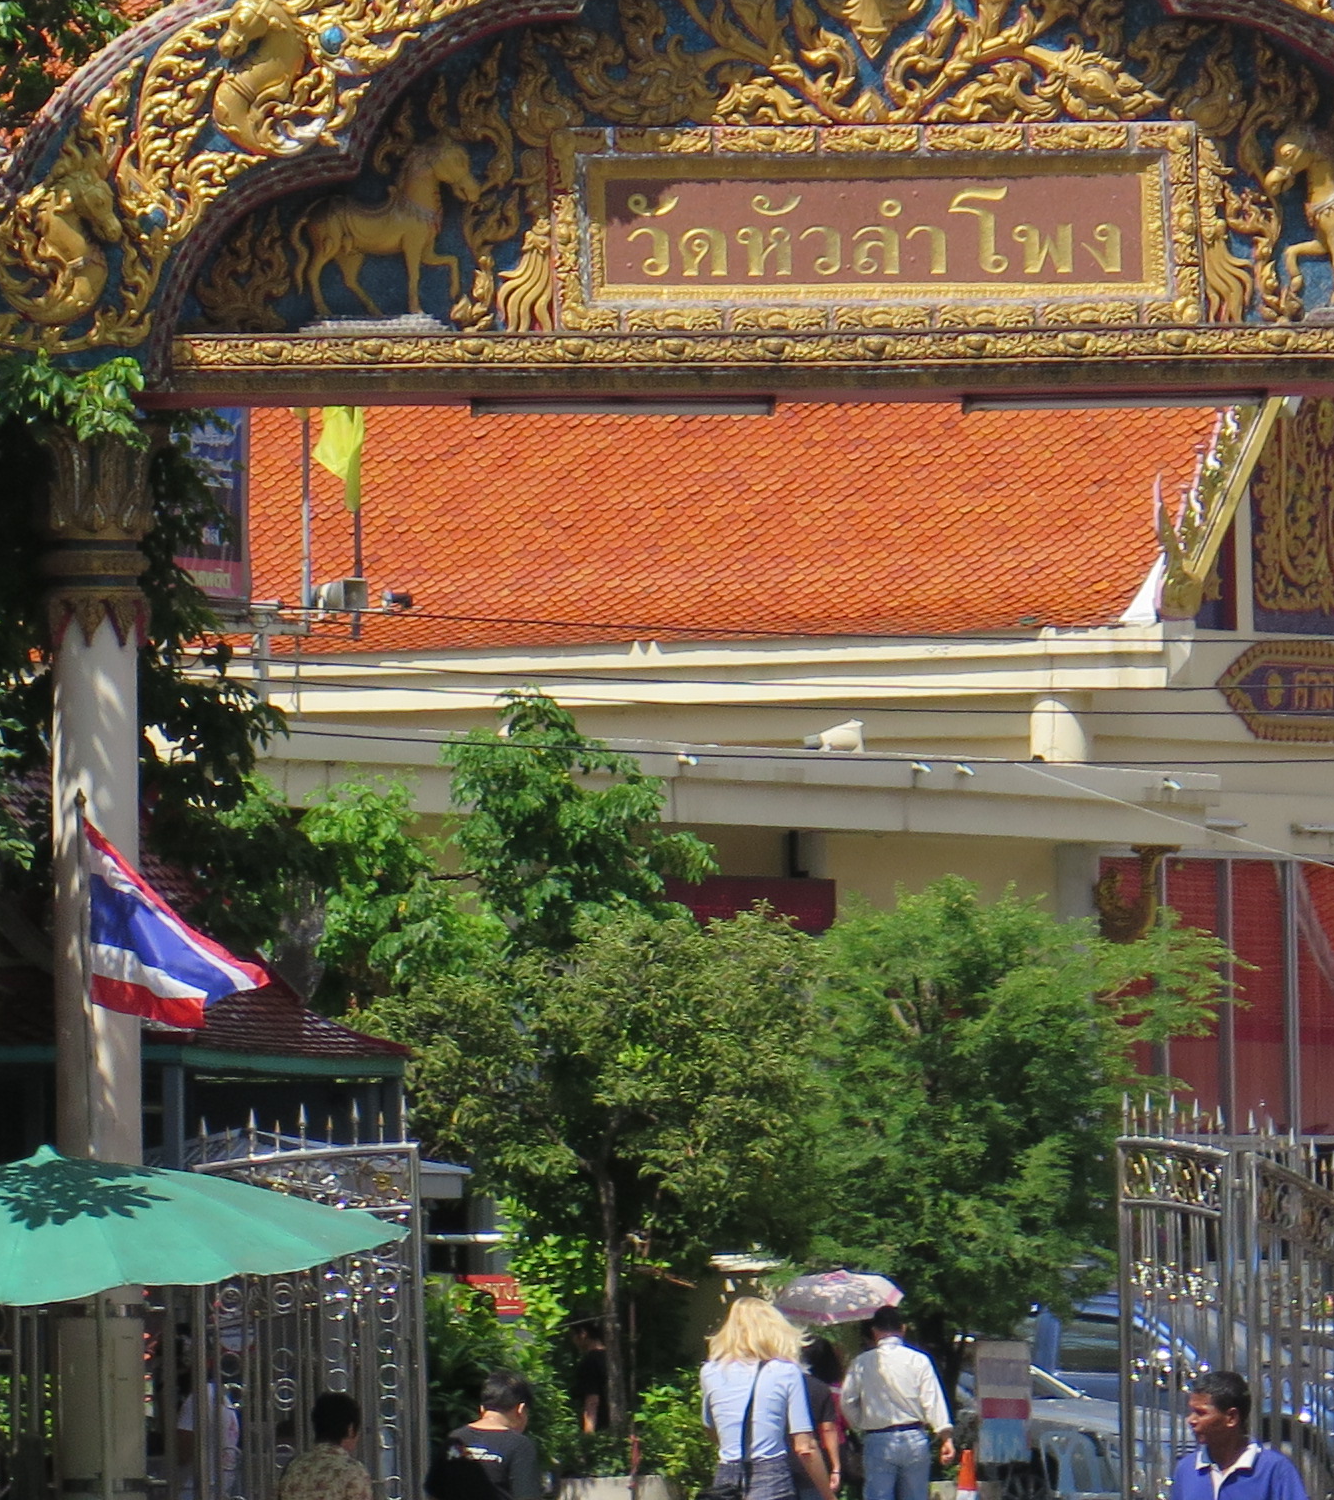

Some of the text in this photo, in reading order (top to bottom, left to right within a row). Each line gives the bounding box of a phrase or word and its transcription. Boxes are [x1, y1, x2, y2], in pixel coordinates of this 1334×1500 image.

[627, 186, 1123, 276] วัดหัวลำโพง
